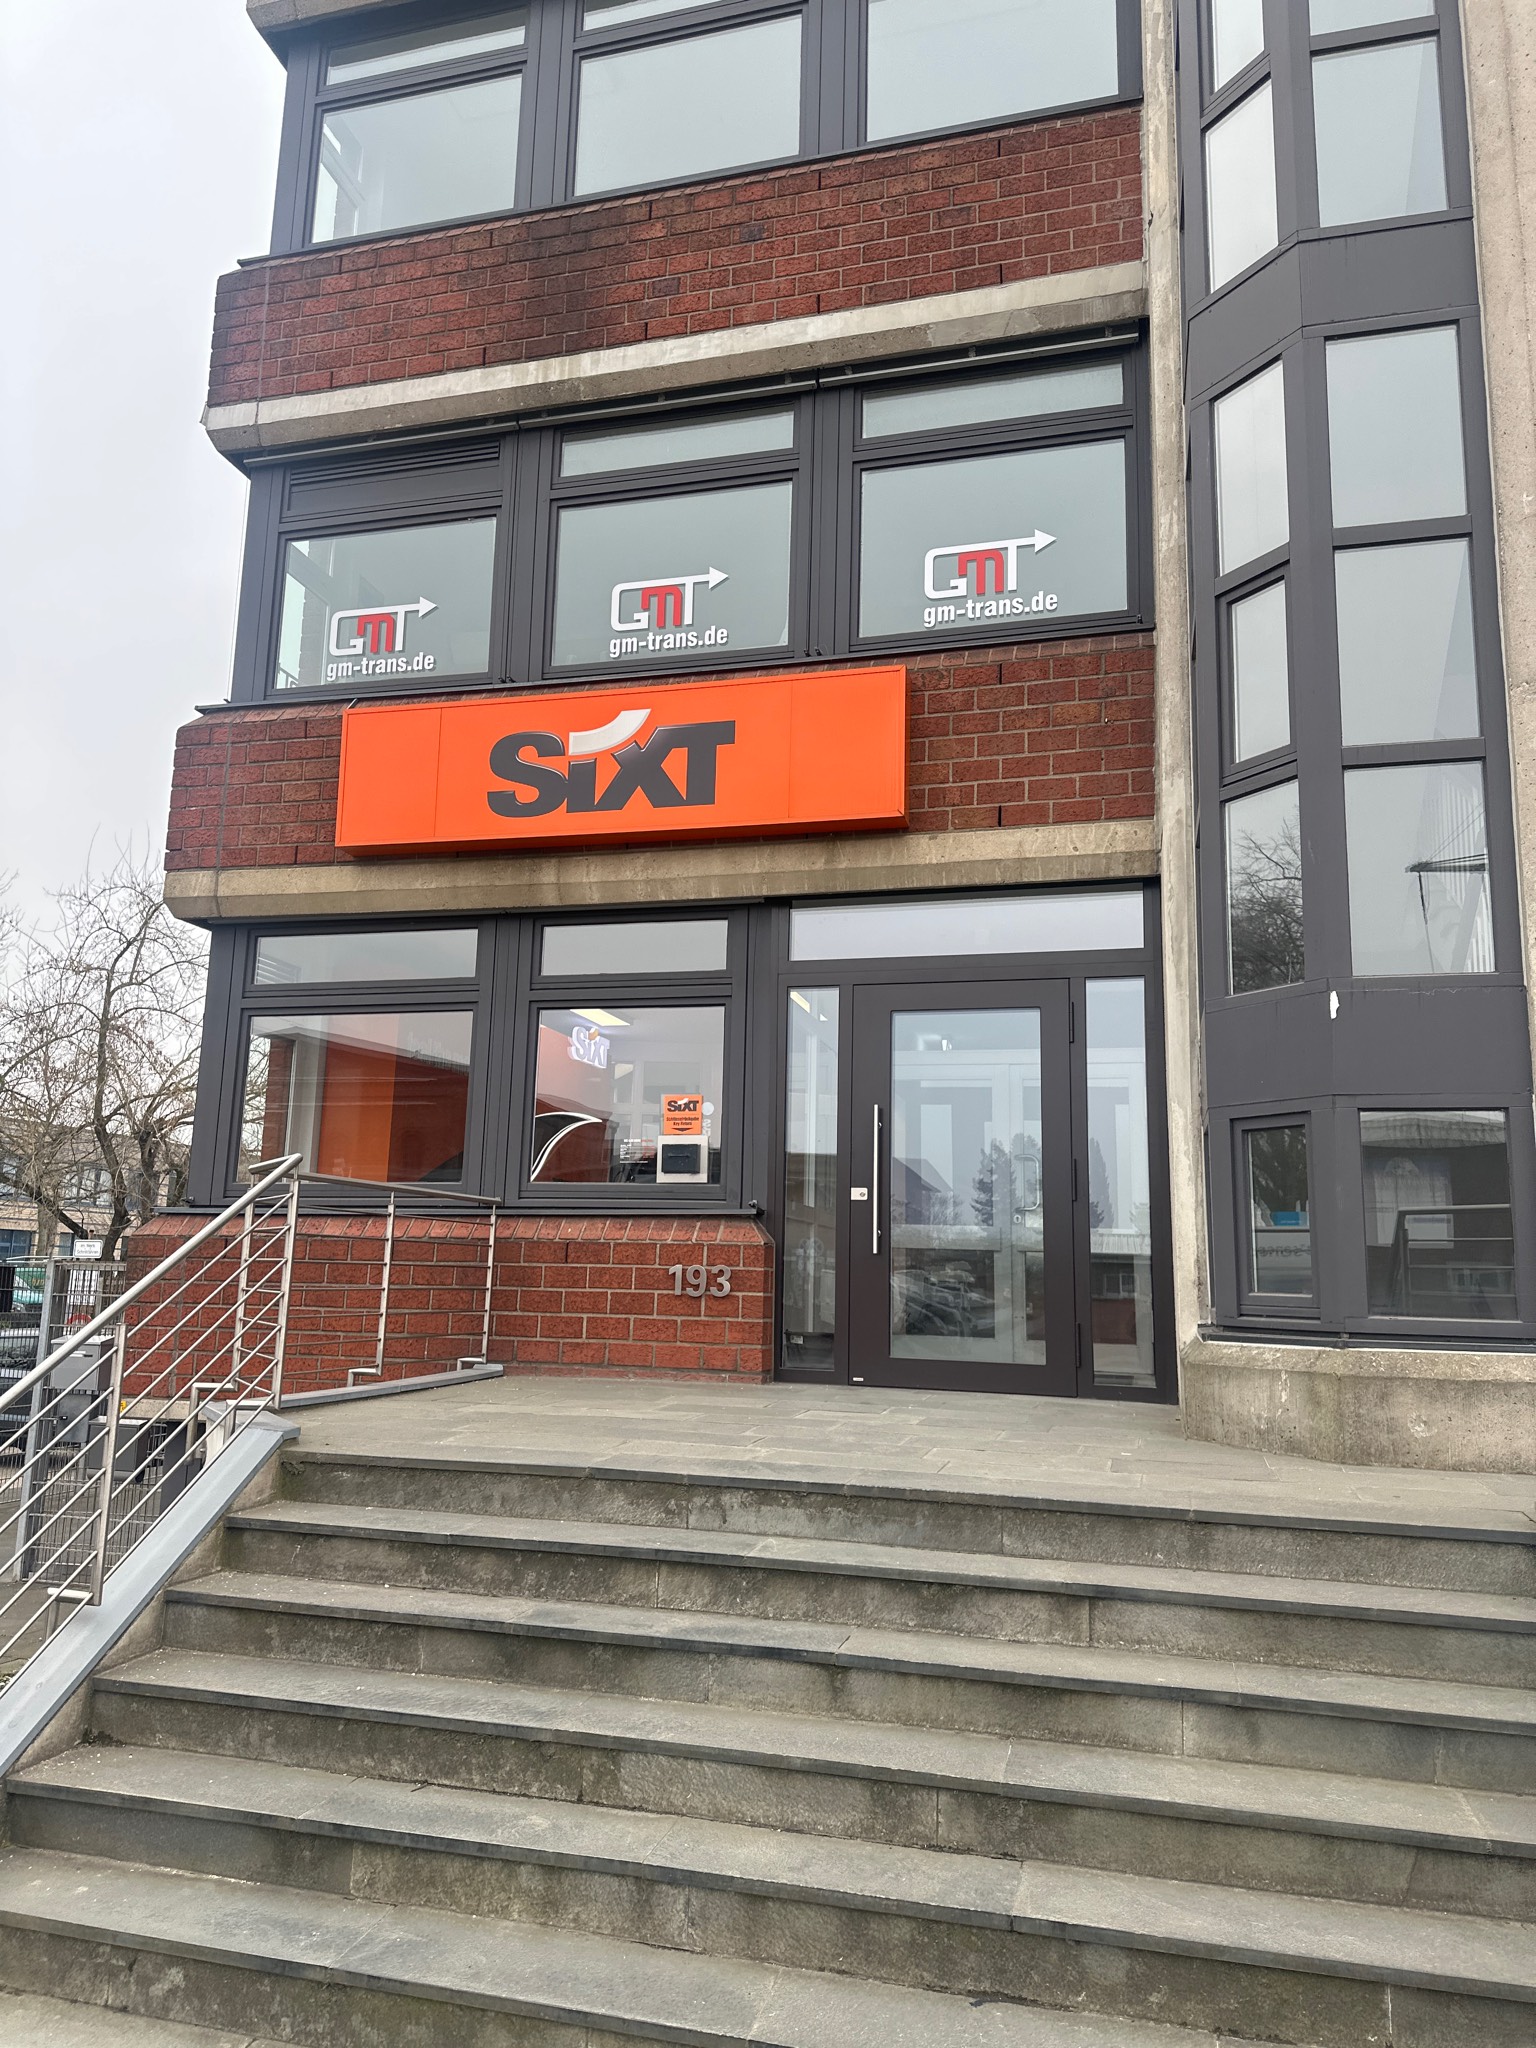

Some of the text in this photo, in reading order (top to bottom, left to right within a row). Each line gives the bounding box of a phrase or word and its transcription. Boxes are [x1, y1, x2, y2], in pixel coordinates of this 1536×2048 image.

[923, 591, 1058, 628] gm-trans.de
[609, 625, 728, 658] gm-trans.de
[326, 652, 434, 681] gm-trans.de
[668, 1264, 731, 1297] 193
